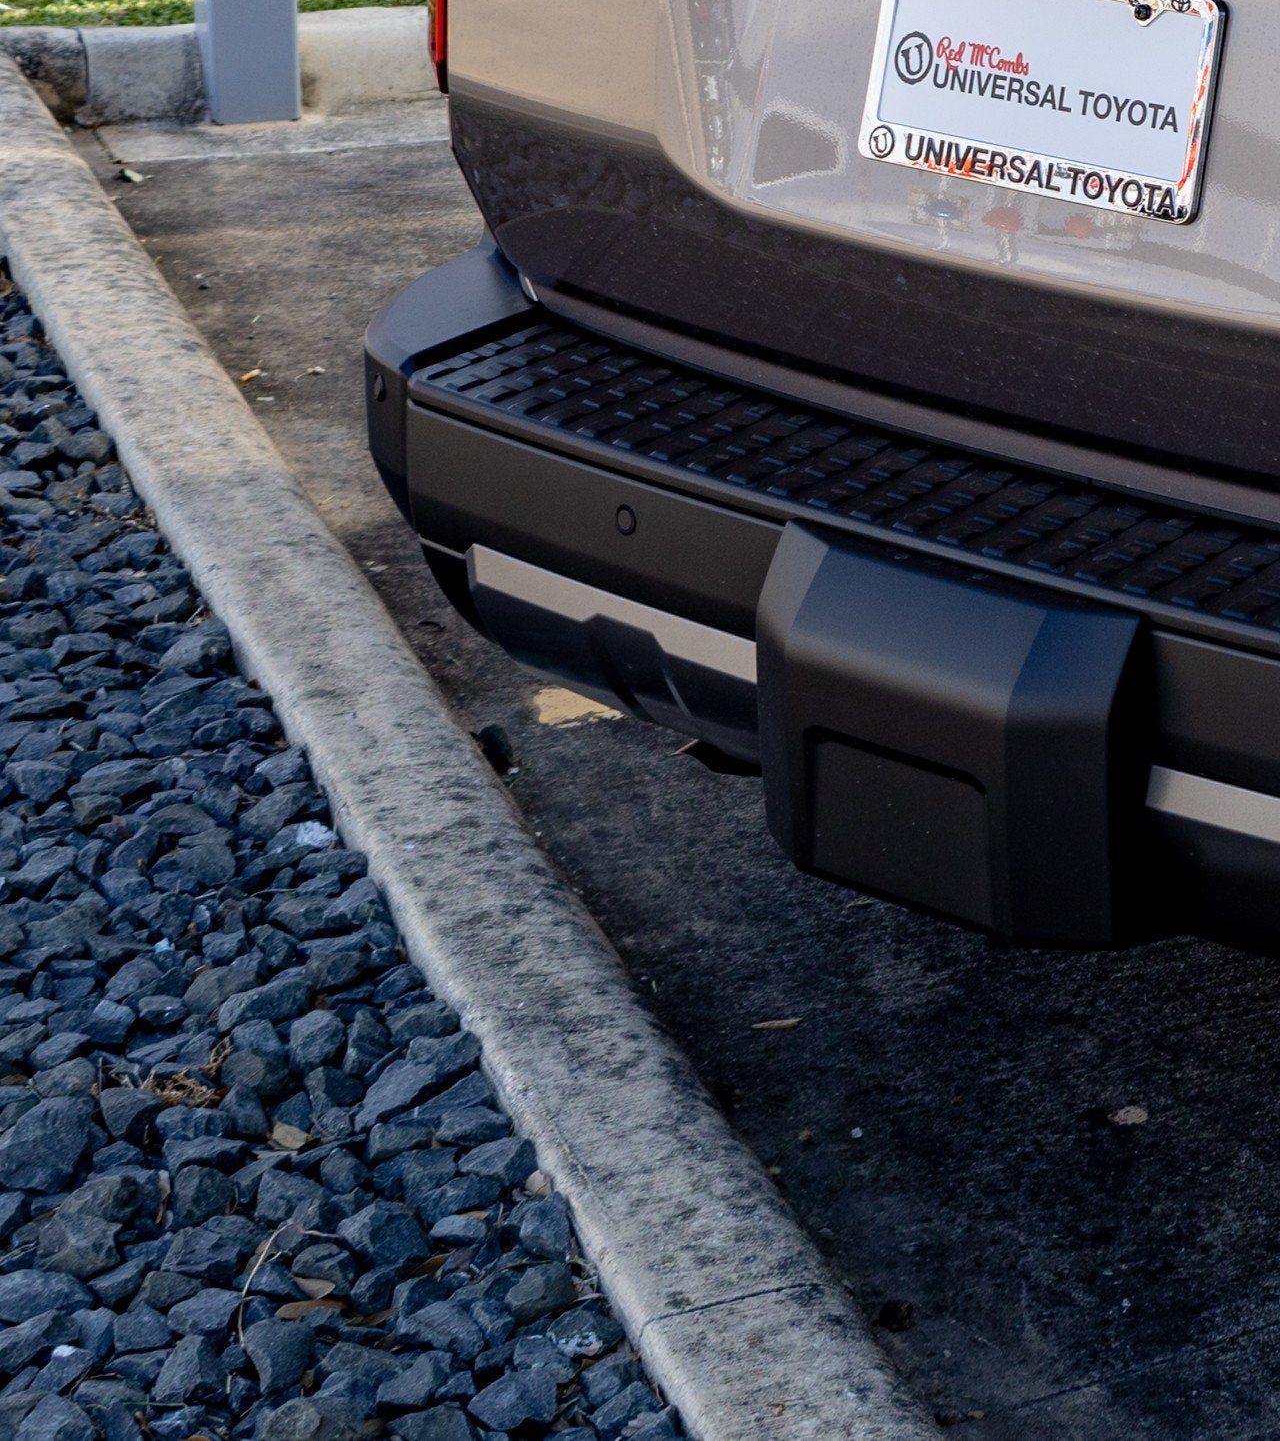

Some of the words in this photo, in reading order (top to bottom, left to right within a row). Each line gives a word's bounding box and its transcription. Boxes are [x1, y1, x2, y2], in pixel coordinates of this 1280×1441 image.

[935, 35, 964, 71] Red
[966, 41, 1030, 76] McCombs
[931, 63, 1073, 113] UNIVERSAL
[1078, 89, 1180, 133] TOYOTA
[904, 132, 1061, 192] UNIVERSAL
[1065, 165, 1177, 216] TOYOTA
